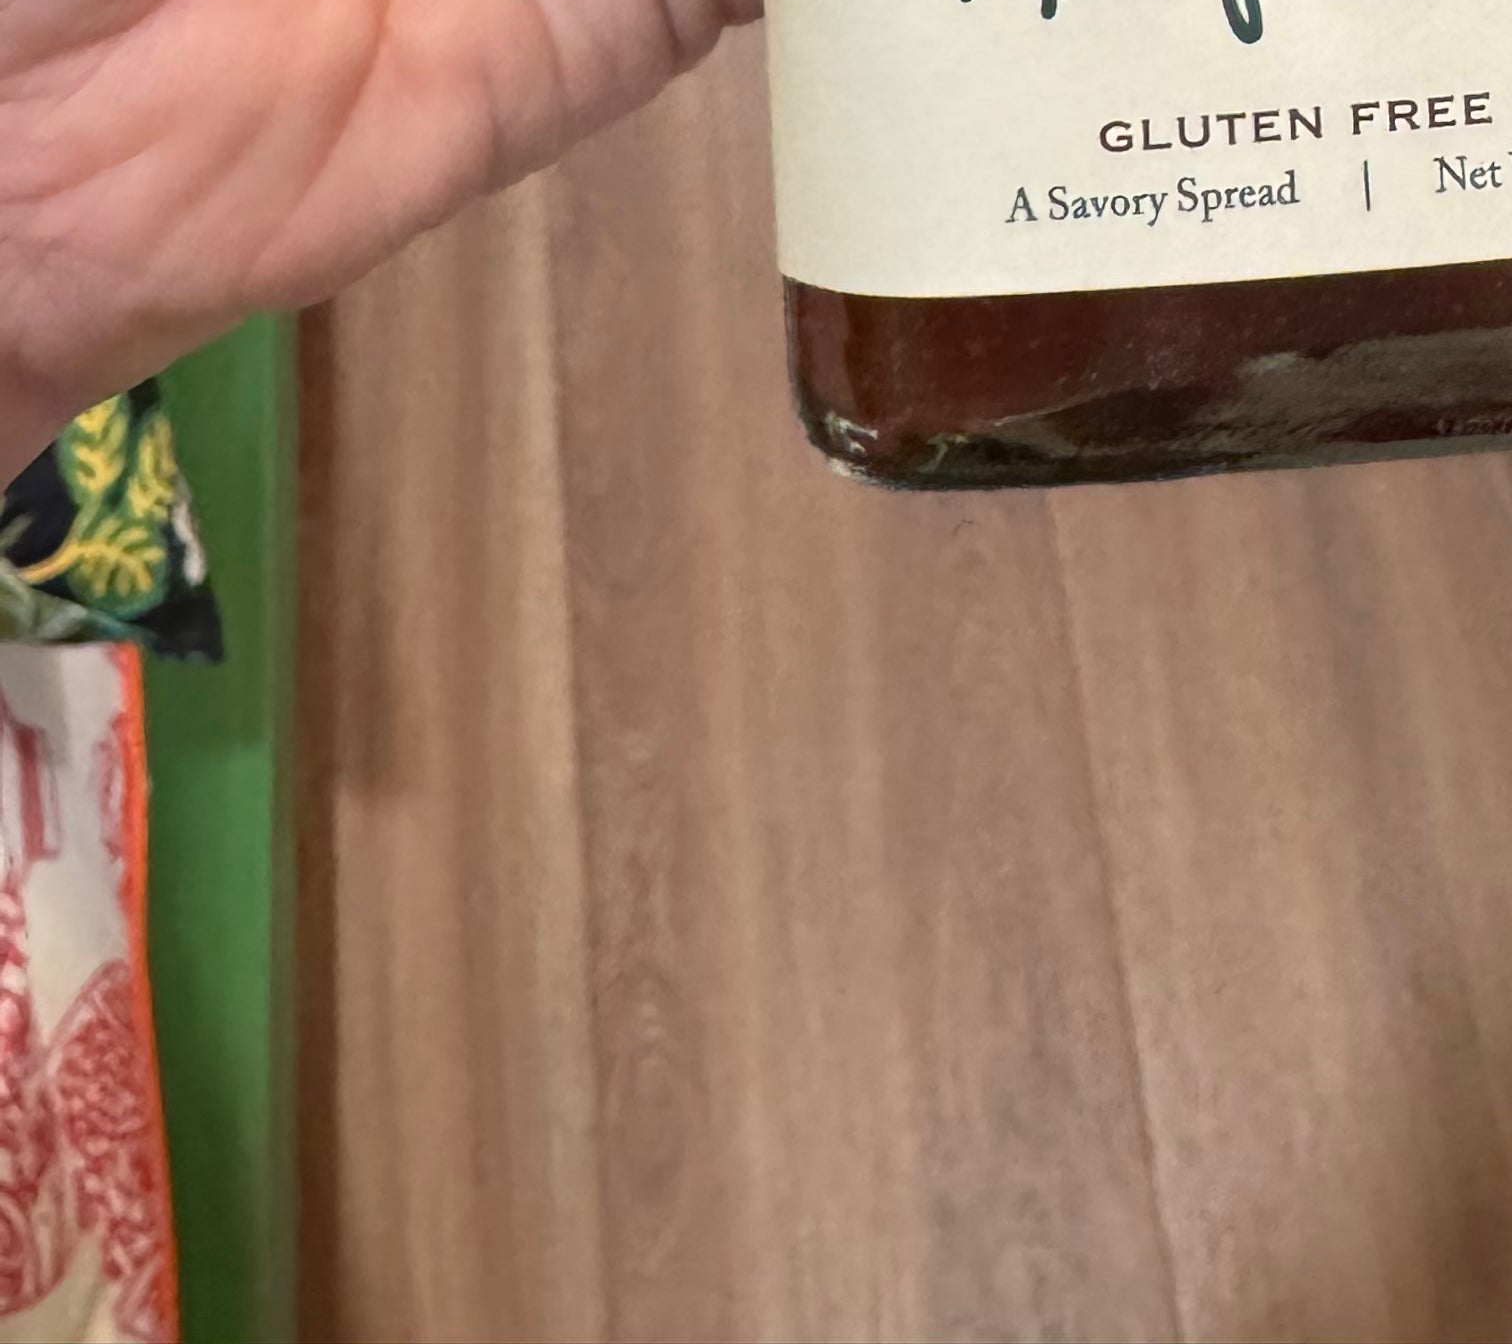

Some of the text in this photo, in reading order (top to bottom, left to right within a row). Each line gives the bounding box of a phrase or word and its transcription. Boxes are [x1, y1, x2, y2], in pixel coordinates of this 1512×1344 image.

[1099, 106, 1322, 152] GLUTEN
[1350, 92, 1492, 135] FREE
[1005, 169, 1300, 227] A Savory Spread
[1433, 156, 1502, 193] Net
